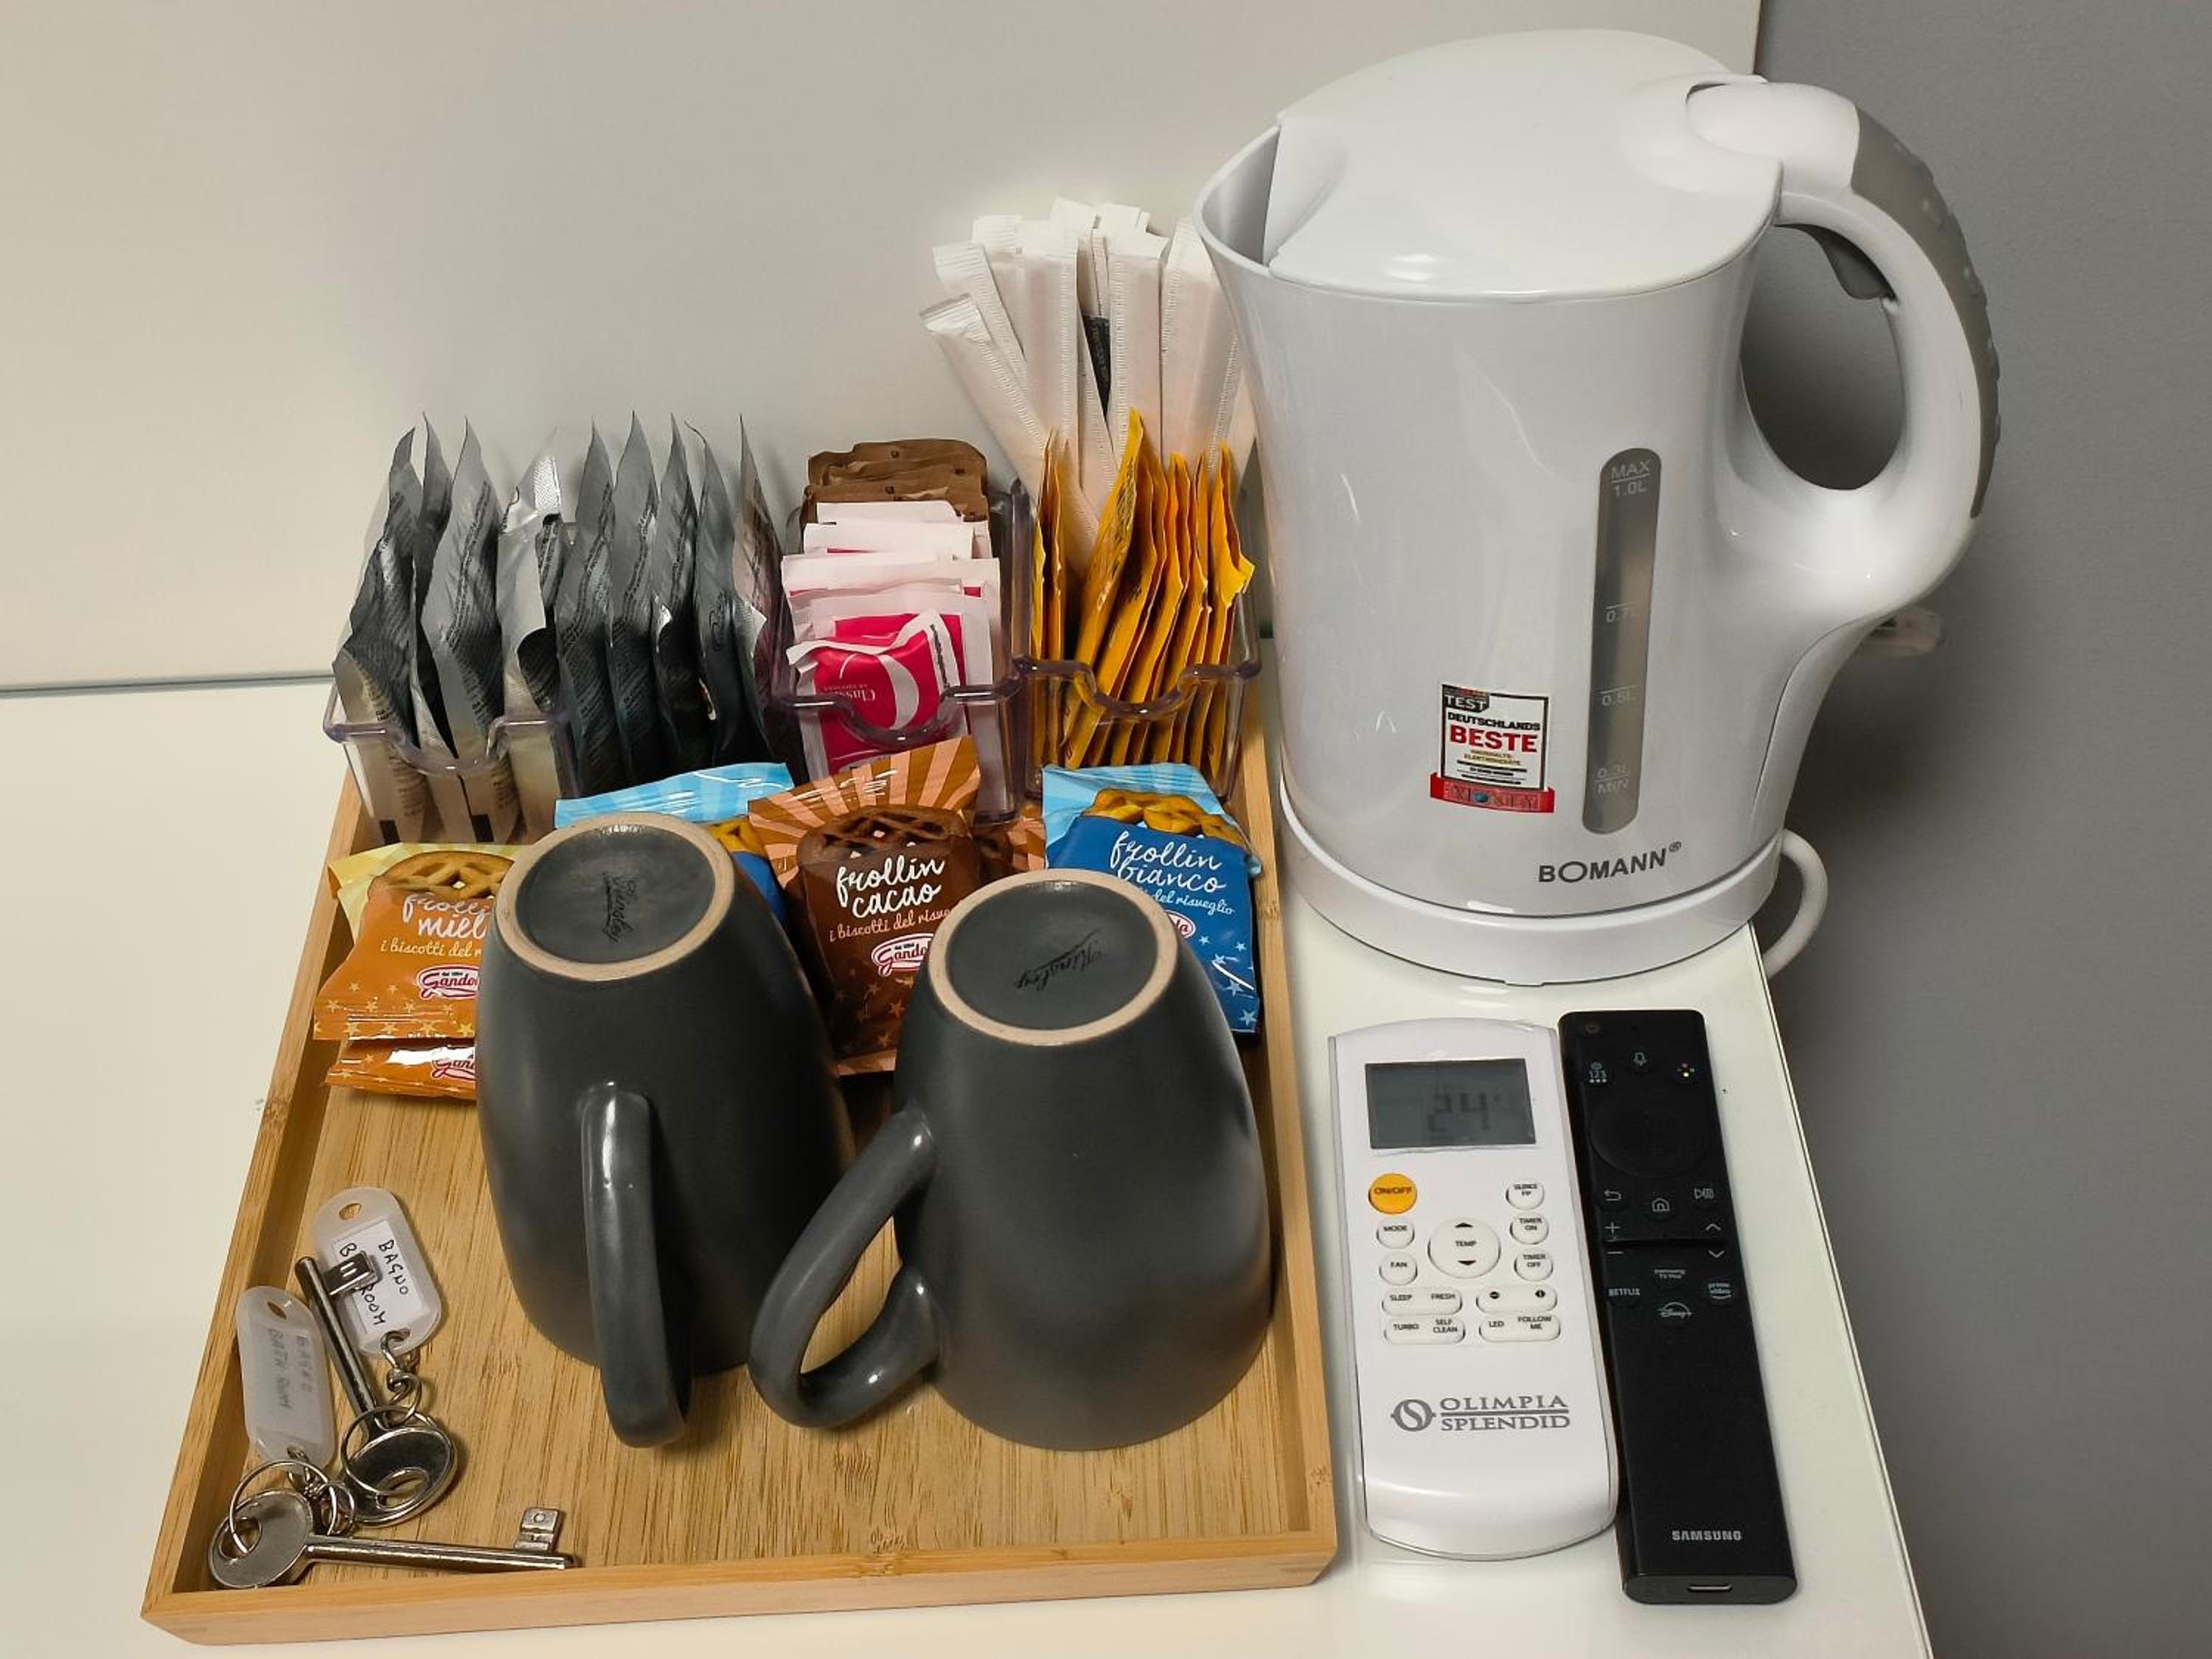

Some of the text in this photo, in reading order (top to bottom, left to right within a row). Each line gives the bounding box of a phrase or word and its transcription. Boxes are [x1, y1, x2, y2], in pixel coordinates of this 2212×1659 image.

[1610, 459, 1651, 479] MAX
[1445, 694, 1487, 710] TEST
[1447, 712, 1540, 731] DEUTSCHLANDS
[1450, 724, 1537, 753] BESTE
[1110, 831, 1223, 871] frollin
[836, 855, 946, 908] frollin
[1117, 857, 1228, 893] bianco
[852, 883, 943, 919] cacao
[837, 919, 890, 939] biscotti
[893, 909, 917, 931] del
[389, 937, 445, 956] biscotti
[448, 941, 473, 958] del
[1373, 1186, 1412, 1194] ON/OFF
[1382, 1224, 1408, 1232] MODE
[378, 1239, 409, 1295] BAGNO
[1608, 1288, 1641, 1296] NETFLIX
[1393, 1323, 1419, 1331] TURBO
[1439, 1394, 1569, 1411] OLIMPIA
[1440, 1414, 1571, 1432] SPLENDID
[1672, 1530, 1742, 1541] SAMSUNG
